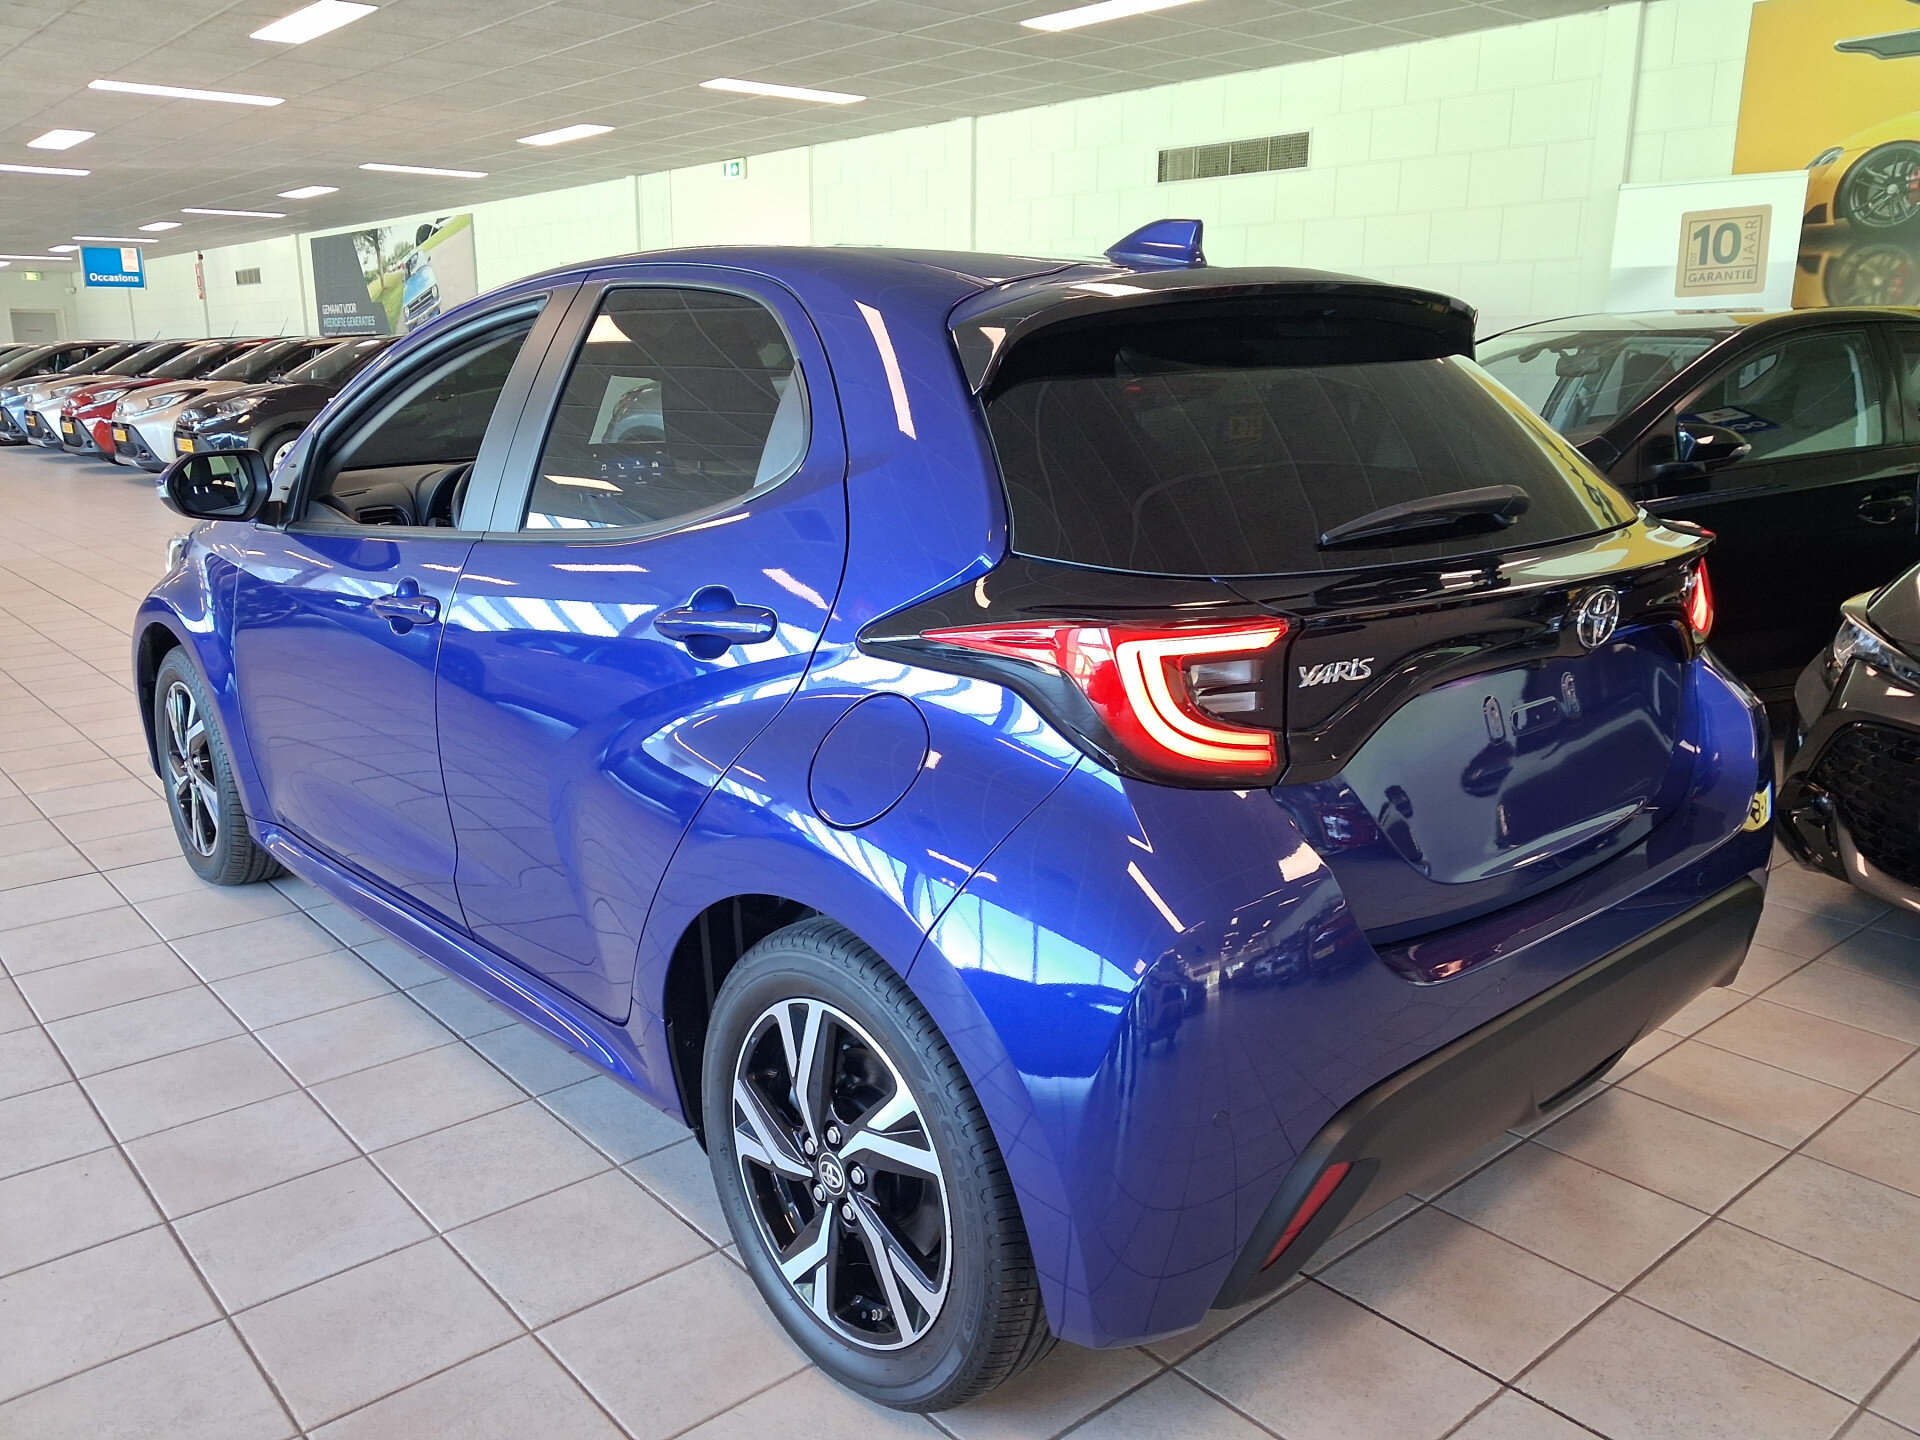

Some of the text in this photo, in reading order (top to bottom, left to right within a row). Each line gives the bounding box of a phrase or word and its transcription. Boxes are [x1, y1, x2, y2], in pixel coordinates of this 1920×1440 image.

[1693, 222, 1741, 265] 10
[1743, 219, 1758, 262] JAAR
[90, 272, 139, 282] Occasions
[1688, 269, 1753, 283] GARANTIE
[343, 303, 357, 313] VOOR
[1298, 657, 1374, 688] YARIS
